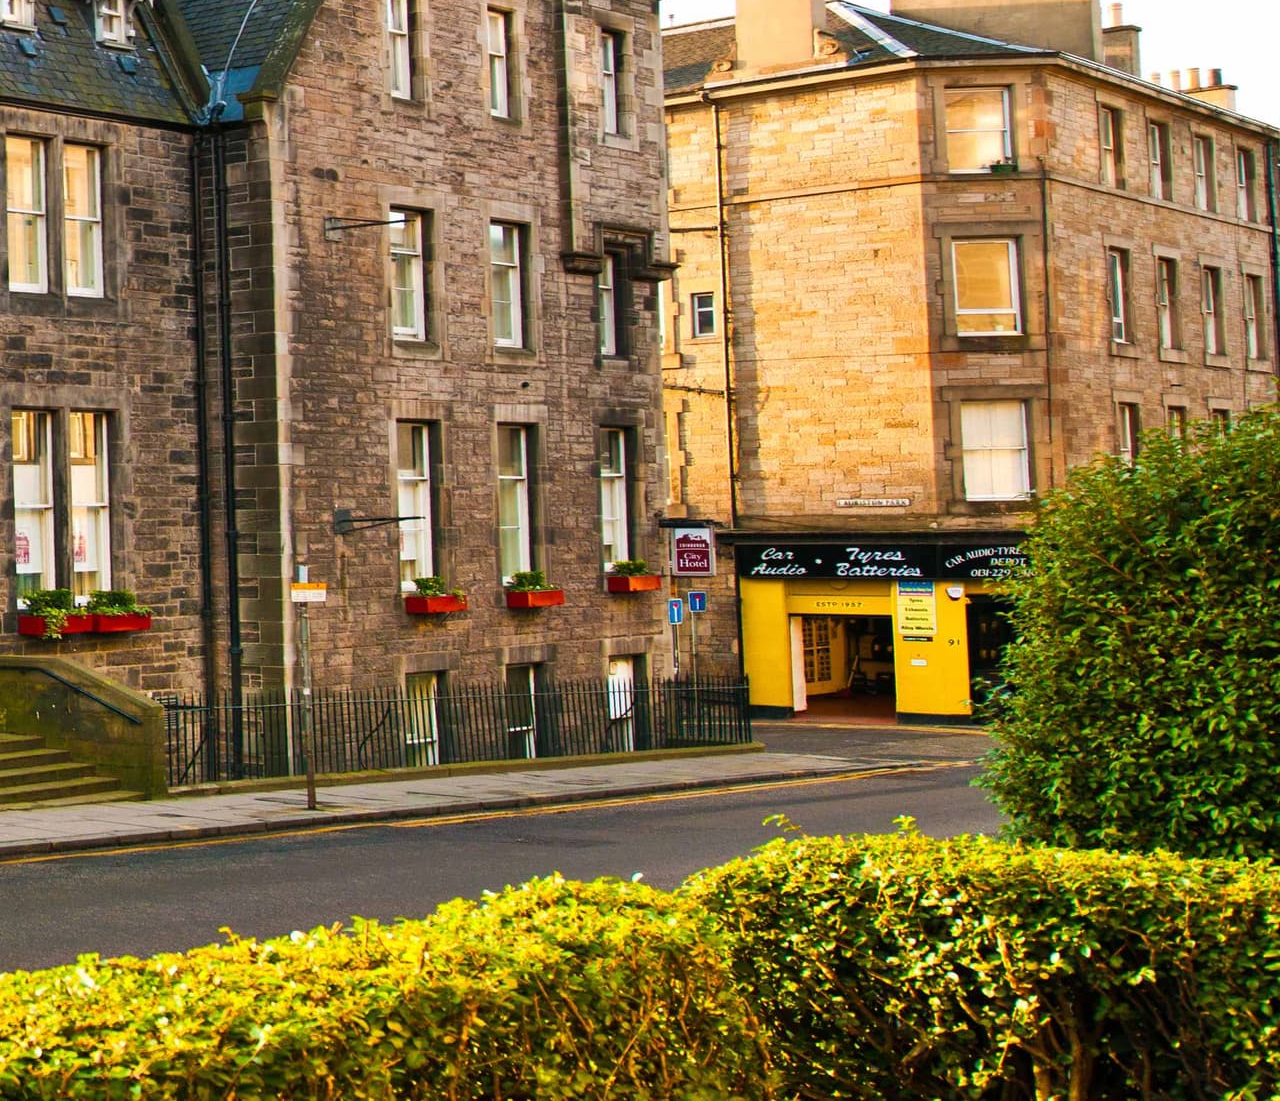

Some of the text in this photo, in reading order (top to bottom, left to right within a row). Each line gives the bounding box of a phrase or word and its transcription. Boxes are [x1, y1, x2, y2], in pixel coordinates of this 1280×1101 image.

[683, 552, 702, 561] City
[761, 548, 906, 563] Car Tyres
[945, 555, 965, 568] CAR
[679, 559, 708, 568] Hotel
[751, 563, 924, 577] Audio Batteries
